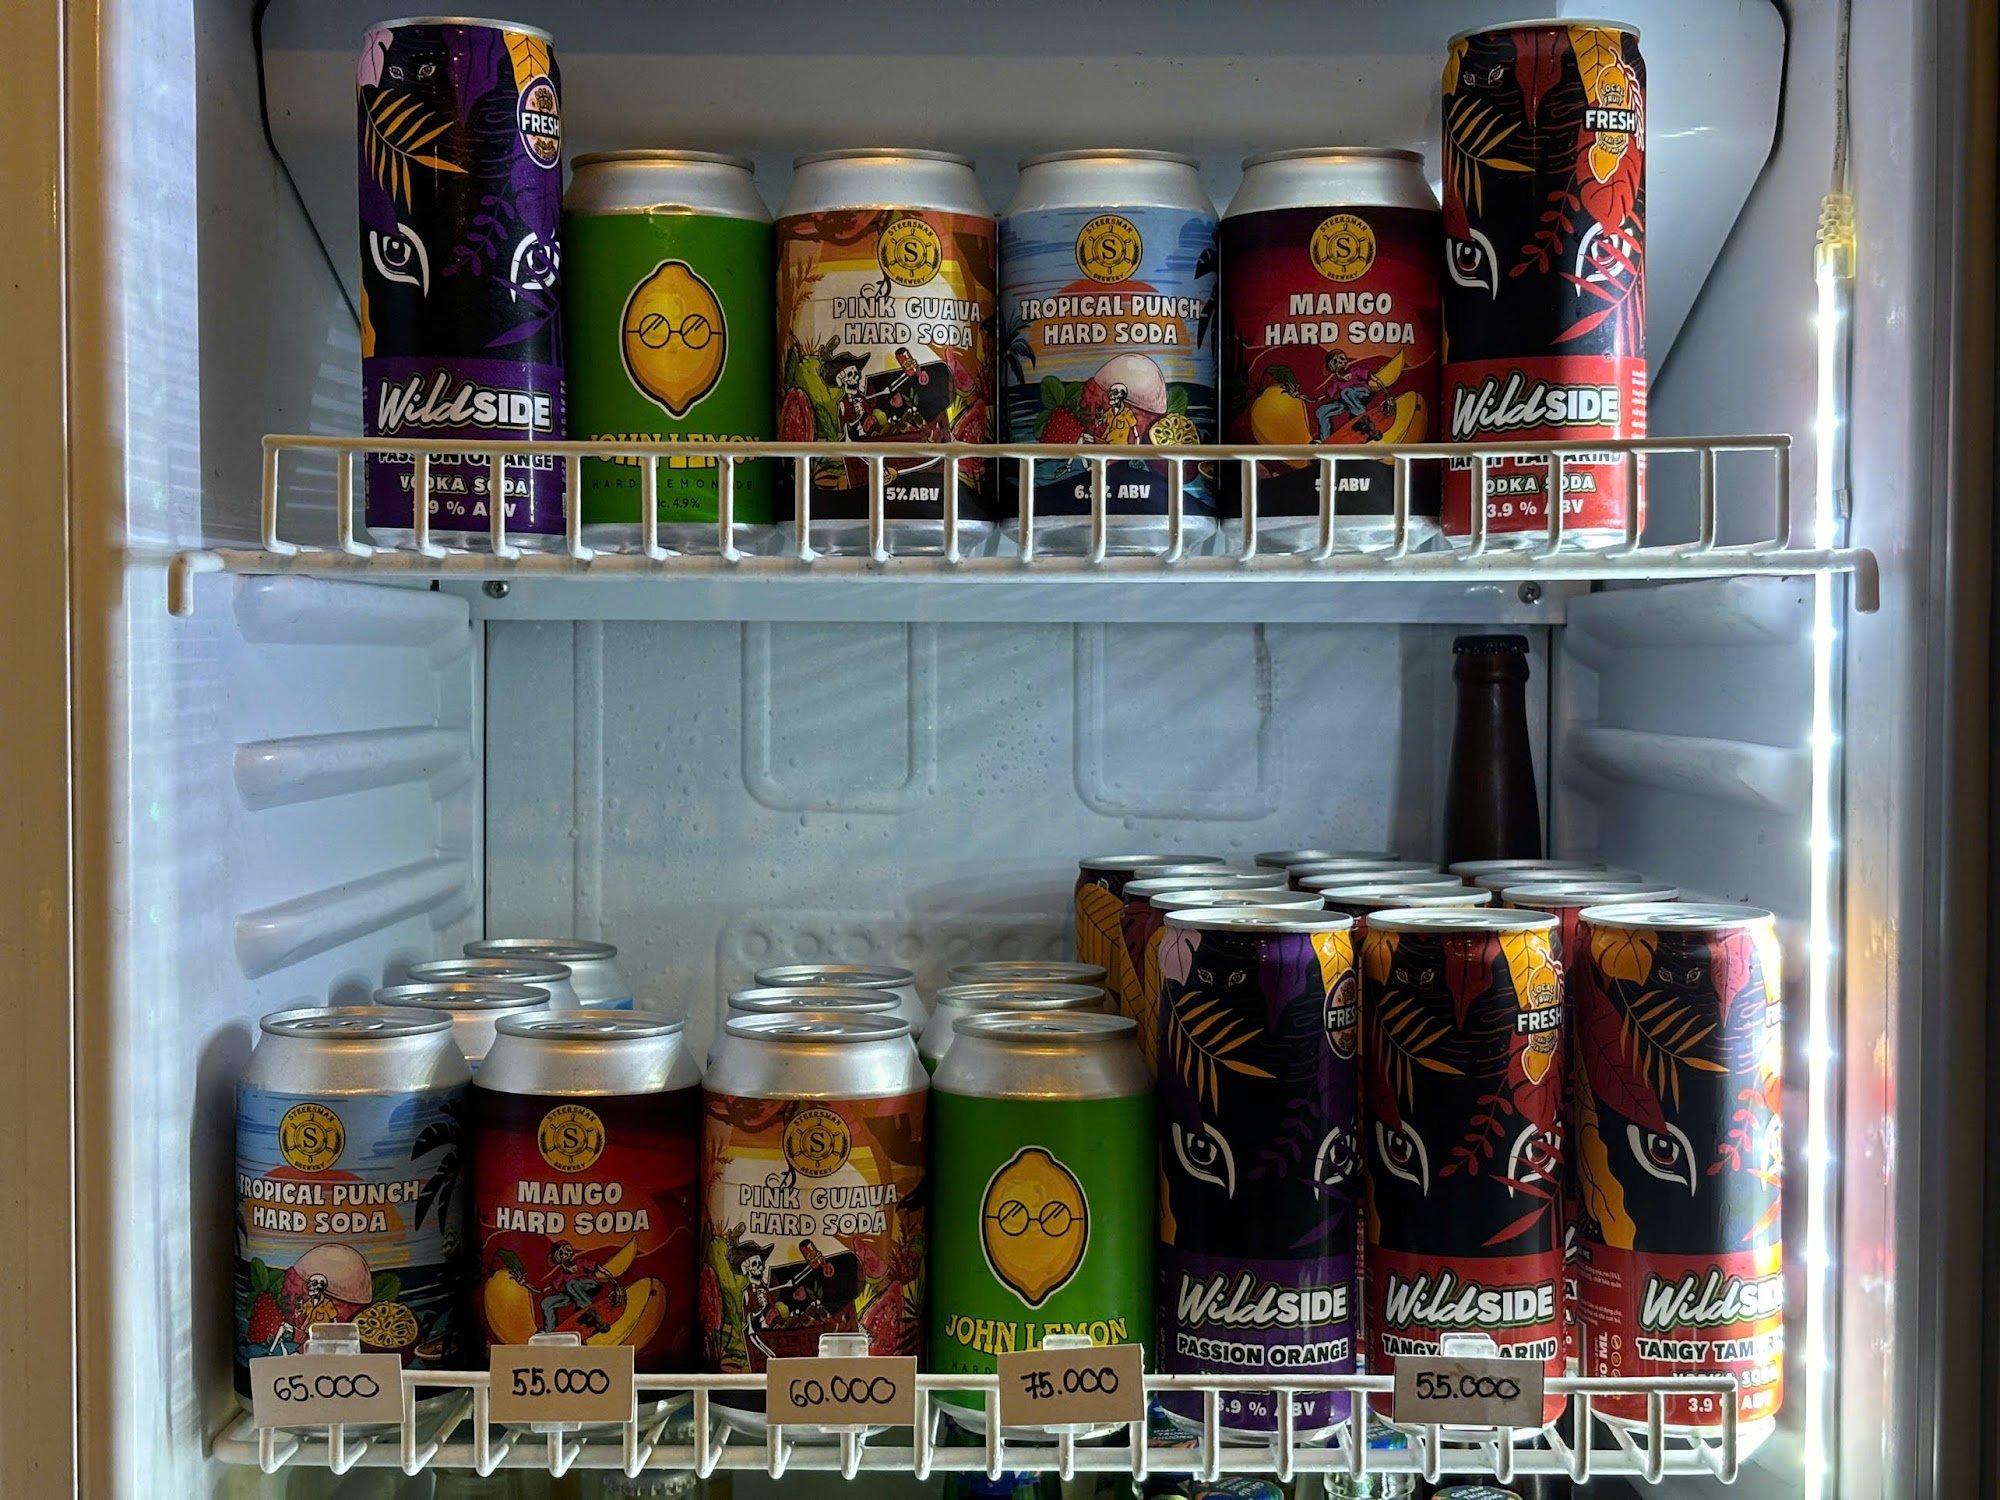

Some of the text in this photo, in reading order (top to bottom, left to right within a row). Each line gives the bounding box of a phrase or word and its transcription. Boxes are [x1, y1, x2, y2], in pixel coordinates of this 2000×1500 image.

[1600, 83, 1626, 97] LOCAL
[521, 111, 560, 138] FRESH
[1585, 109, 1636, 132] FRESH
[888, 221, 933, 237] STEERSMAN
[1085, 218, 1133, 234] STEERSMAN
[1319, 217, 1368, 233] STEERSMAN
[903, 242, 918, 262] S
[1102, 239, 1117, 260] S
[1336, 237, 1351, 258] S
[895, 275, 926, 285] BREWERY
[1093, 273, 1124, 282] BREWERY
[1327, 271, 1358, 281] BREWERY
[832, 296, 980, 322] PINK GUAVA
[1020, 297, 1201, 321] TROPICAL PUNCH
[1289, 292, 1393, 317] MANGO
[844, 323, 973, 348] HARD SODA
[1043, 322, 1179, 346] HARD SODA
[1265, 320, 1416, 347] HARD SODA
[590, 432, 662, 469] OHN
[472, 476, 529, 497] SDA
[592, 478, 753, 491] HARD EMONDE
[886, 486, 940, 502] 5% ABV
[1073, 484, 1151, 501] 6. ABV
[1337, 477, 1371, 492] ABV
[1485, 473, 1596, 496] ODKA ODA
[472, 502, 516, 517] AV
[672, 497, 700, 509] 4.9%
[1486, 503, 1513, 518] 3.9
[1544, 499, 1584, 515] BV
[1517, 1006, 1562, 1033] FRESH
[288, 1105, 335, 1122] STEERSMAN
[547, 1106, 596, 1122] STEERSMAN
[793, 1110, 842, 1127] STEERSMAN
[303, 1126, 318, 1148] S
[563, 1127, 578, 1149] S
[810, 1132, 825, 1153] S
[294, 1161, 325, 1170] BREWERY
[554, 1161, 585, 1170] BREWERY
[800, 1166, 832, 1175] BREWERY
[239, 1175, 420, 1206] TROPICAL PUNCH
[517, 1180, 623, 1206] MANGO
[739, 1182, 898, 1209] PINK GUAVA
[252, 1206, 387, 1233] HARD SODA
[496, 1207, 649, 1235] HARD SODA
[750, 1210, 888, 1236] HARD SODA
[945, 1313, 1017, 1354] JOHN
[1177, 1333, 1349, 1366] PASSION ORANGE
[1381, 1333, 1440, 1357] TANGY
[1499, 1337, 1558, 1360] ARIND
[1636, 1338, 1709, 1361] TANGY
[273, 1374, 380, 1402] 65.000
[511, 1367, 610, 1396] 55.000
[789, 1376, 896, 1408] 60.000
[1020, 1367, 1119, 1400] 75.000
[1416, 1371, 1521, 1400] 55.000
[1687, 1397, 1713, 1412] 3.9
